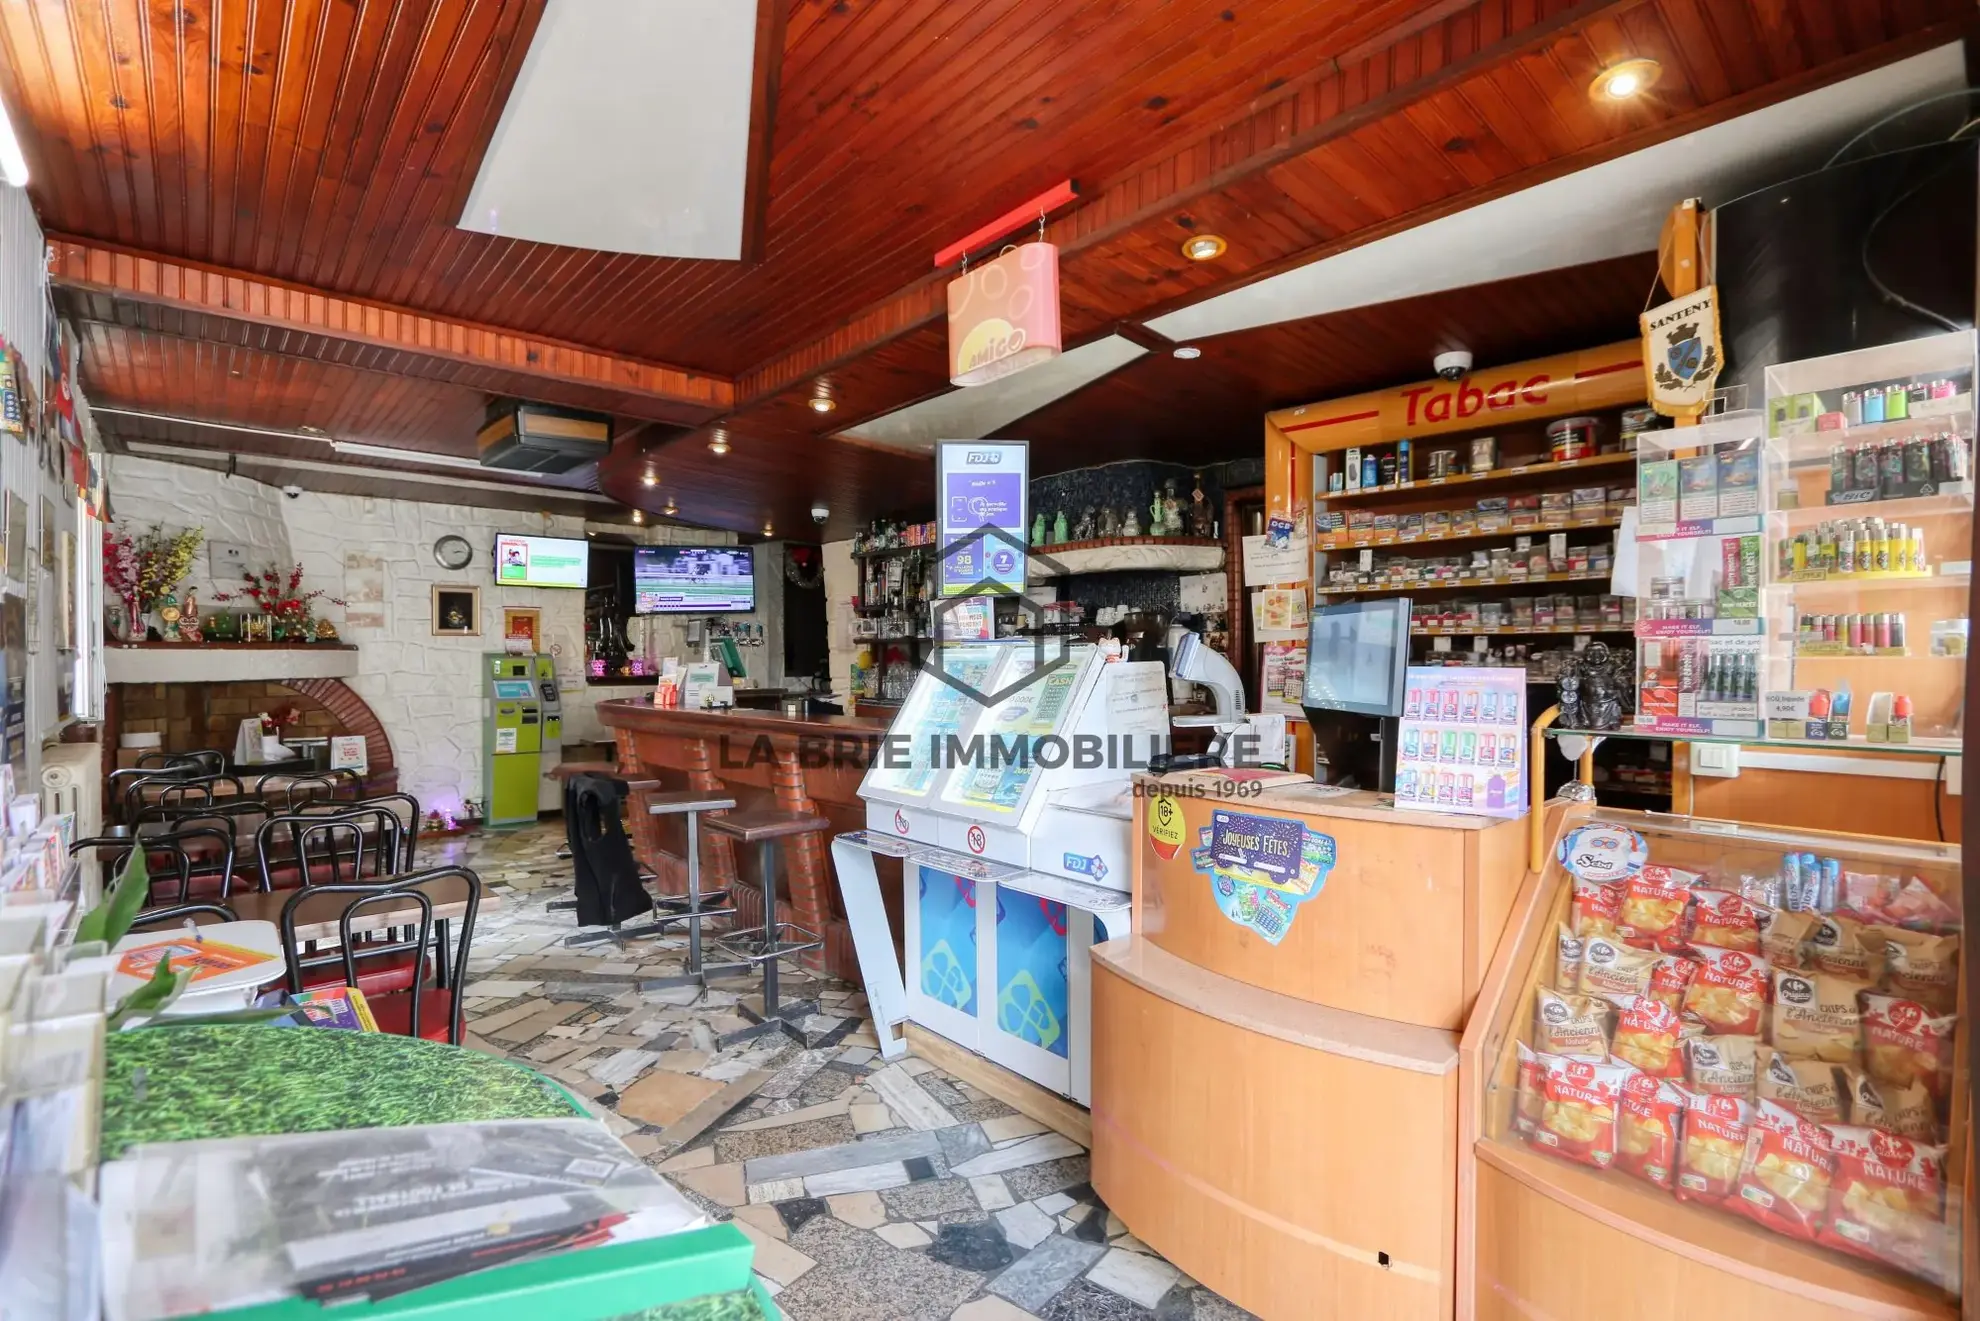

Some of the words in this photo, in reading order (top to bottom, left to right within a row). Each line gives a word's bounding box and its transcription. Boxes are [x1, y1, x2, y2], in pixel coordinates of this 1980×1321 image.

[1650, 299, 1711, 330] SANTENY
[1400, 374, 1550, 426] Tabac
[1271, 520, 1292, 529] OCB
[957, 555, 972, 564] 98
[1000, 554, 1009, 564] 7
[1049, 674, 1075, 686] CASH
[1160, 805, 1174, 817] 18+
[1222, 829, 1260, 851] JOYEUSES
[1263, 835, 1289, 857] FÊTES
[1066, 857, 1087, 872] FDJ
[1632, 885, 1677, 899] NATURE
[1704, 914, 1748, 927] NATURE
[1704, 971, 1754, 989] NATURE
[1872, 1026, 1926, 1051] NATURE
[1863, 1163, 1927, 1191] NATURE
